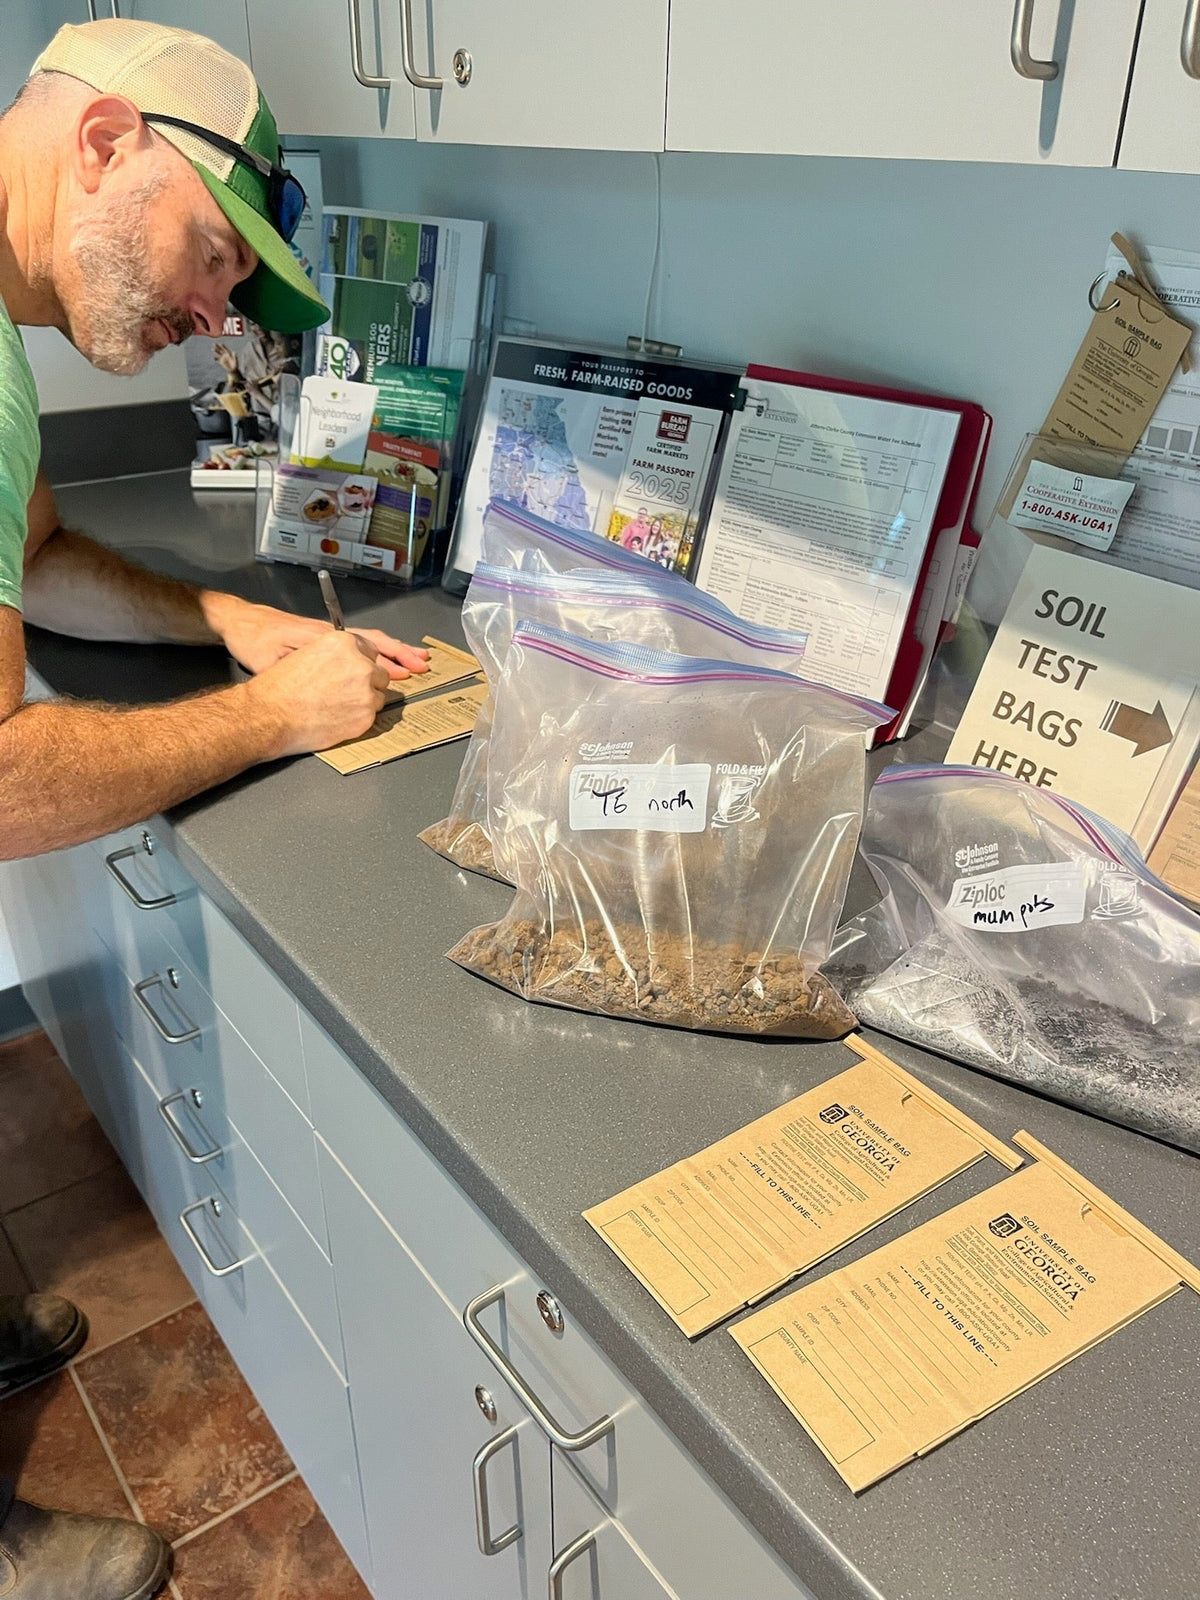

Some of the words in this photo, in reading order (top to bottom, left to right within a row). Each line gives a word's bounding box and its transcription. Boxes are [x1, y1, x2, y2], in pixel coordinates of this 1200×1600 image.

[1160, 294, 1200, 304] OPERATIVE
[222, 316, 242, 335] ME
[369, 323, 377, 341] SOD
[1113, 315, 1128, 328] SOIL
[1126, 323, 1150, 343] SAMPLE
[1148, 337, 1163, 351] BAG
[377, 323, 391, 366] NERS
[1097, 341, 1107, 351] The
[366, 343, 375, 382] PREMIUM
[580, 360, 598, 369] YOUR
[600, 363, 634, 375] PASSPORT
[532, 363, 569, 381] FRESH,
[570, 369, 644, 393] FARM-RAISED
[645, 381, 693, 400] GOODS
[312, 406, 361, 421] Neighborhood
[320, 421, 347, 433] Leaders
[661, 422, 687, 432] BUREAU
[670, 416, 688, 425] FARM
[763, 412, 798, 424] EXTENSION
[657, 442, 682, 451] CERTIFIED
[664, 450, 688, 460] MARKETS
[632, 459, 654, 469] FARM
[656, 464, 695, 478] PASSPORT
[626, 471, 691, 505] 2025
[1025, 484, 1078, 505] COOPERATIVE
[1078, 498, 1119, 515] EXTENSION
[1020, 499, 1113, 532] 1-800-ASK-UGA1
[1035, 589, 1107, 639] SOIL
[1017, 639, 1098, 691] TEST
[992, 690, 1083, 748] BAGS
[579, 773, 629, 799] Ziploc
[648, 789, 694, 811] north
[1097, 861, 1117, 871] OLD
[960, 884, 1005, 908] Ziploc
[974, 909, 1015, 924] mum
[1020, 895, 1054, 927] pots
[847, 1104, 866, 1119] SOIL
[864, 1118, 894, 1143] SAMPLE
[892, 1142, 912, 1157] BAG
[849, 1121, 890, 1155] UNIVERSITY
[890, 1156, 902, 1165] OF
[828, 1132, 865, 1163] Environmental
[863, 1162, 886, 1181] Sciences
[832, 1129, 852, 1146] College
[856, 1150, 886, 1175] Agricultural
[838, 1123, 898, 1171] GEORGIA
[764, 1177, 777, 1188] TO
[775, 1186, 794, 1202] THIS
[1020, 1215, 1042, 1233] SOIL
[1039, 1232, 1077, 1264] SAMPLE
[1074, 1264, 1097, 1284] BAG
[1022, 1235, 1074, 1281] UNIVERSITY
[1073, 1282, 1086, 1293] OF
[1000, 1248, 1044, 1288] Environmental
[1041, 1287, 1070, 1312] Sciences
[1003, 1266, 1028, 1288] Laboratory
[1004, 1245, 1028, 1266] College
[1026, 1264, 1035, 1272] of
[1032, 1271, 1070, 1305] Agricultural
[1010, 1237, 1084, 1301] GEORGIA
[834, 1297, 846, 1308] CITY
[849, 1289, 870, 1310] ADDRESS
[922, 1273, 934, 1284] you
[931, 1283, 945, 1295] may
[943, 1294, 956, 1304] call
[934, 1255, 956, 1275] Contact
[953, 1274, 983, 1303] information
[980, 1301, 991, 1311] for
[988, 1310, 1003, 1323] your
[1000, 1322, 1022, 1342] county
[935, 1266, 962, 1291] Extension
[959, 1290, 976, 1305] office
[979, 1309, 1001, 1330] located
[791, 1320, 809, 1339] SAMPLE
[806, 1311, 820, 1326] CROP
[930, 1297, 945, 1311] TO
[941, 1309, 965, 1331] THIS
